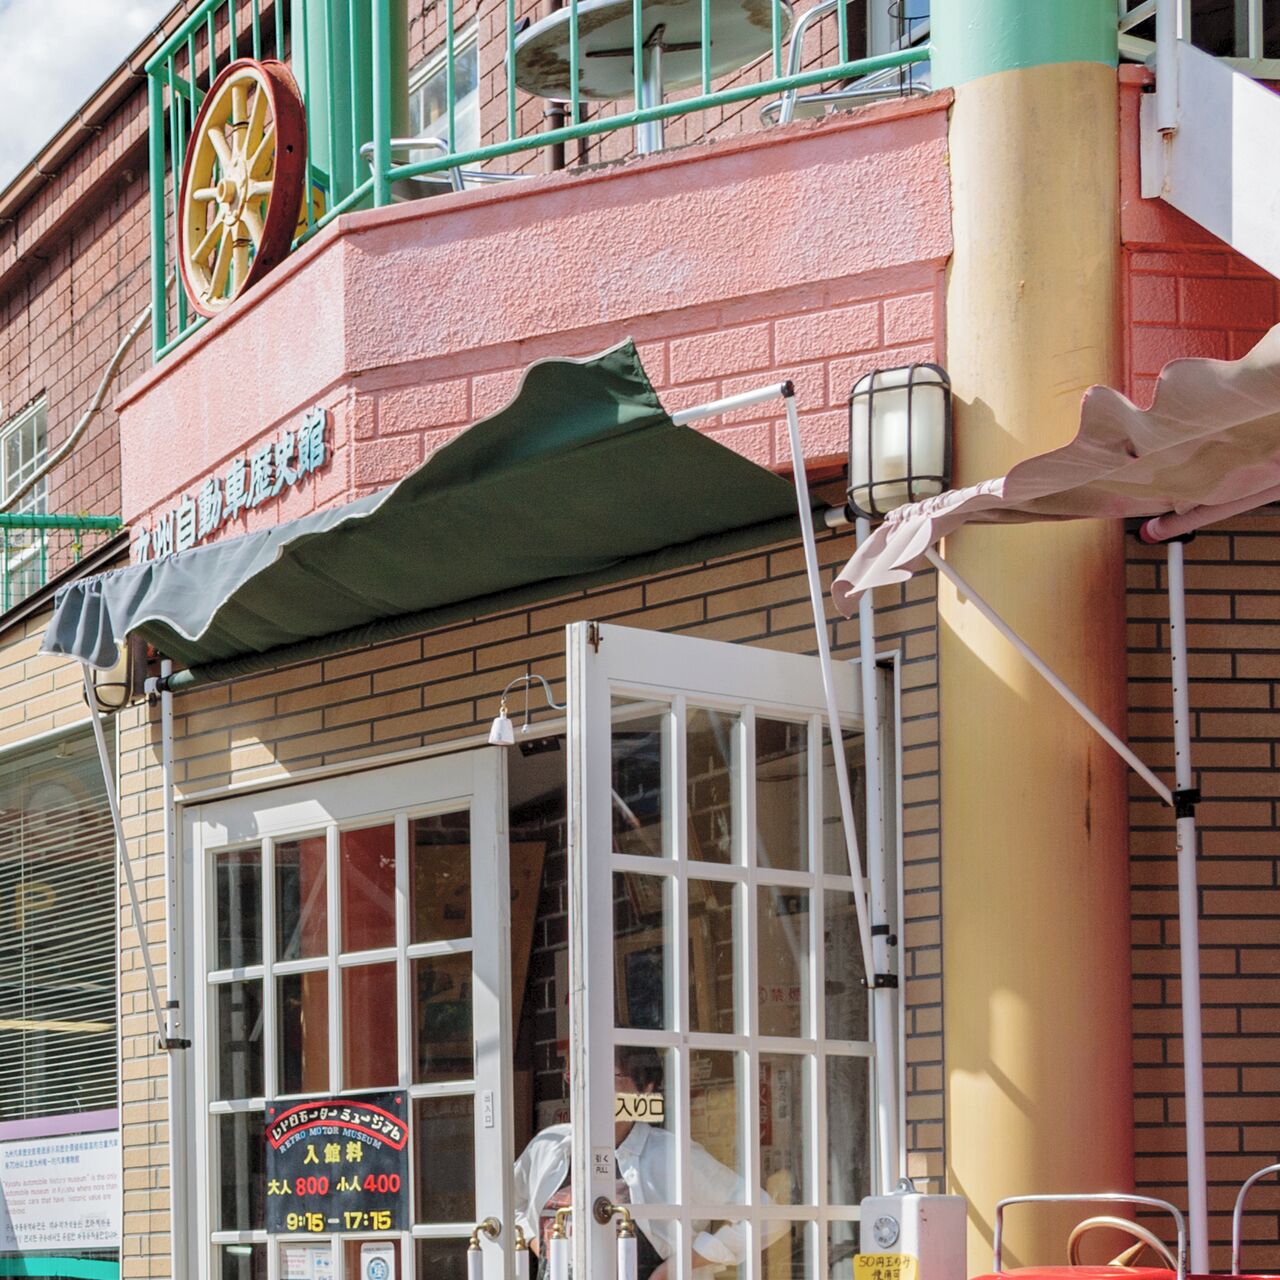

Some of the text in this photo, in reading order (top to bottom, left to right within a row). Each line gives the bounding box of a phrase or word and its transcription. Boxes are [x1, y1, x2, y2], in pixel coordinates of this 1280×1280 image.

[615, 1096, 664, 1118] 入り口
[279, 1126, 382, 1154] RETRO MOTOR MUSEUM
[303, 1141, 364, 1165] 入館料
[267, 1173, 401, 1197] 大人 800 小人 400
[286, 1212, 325, 1232] 9:15
[343, 1210, 392, 1231] 17:15
